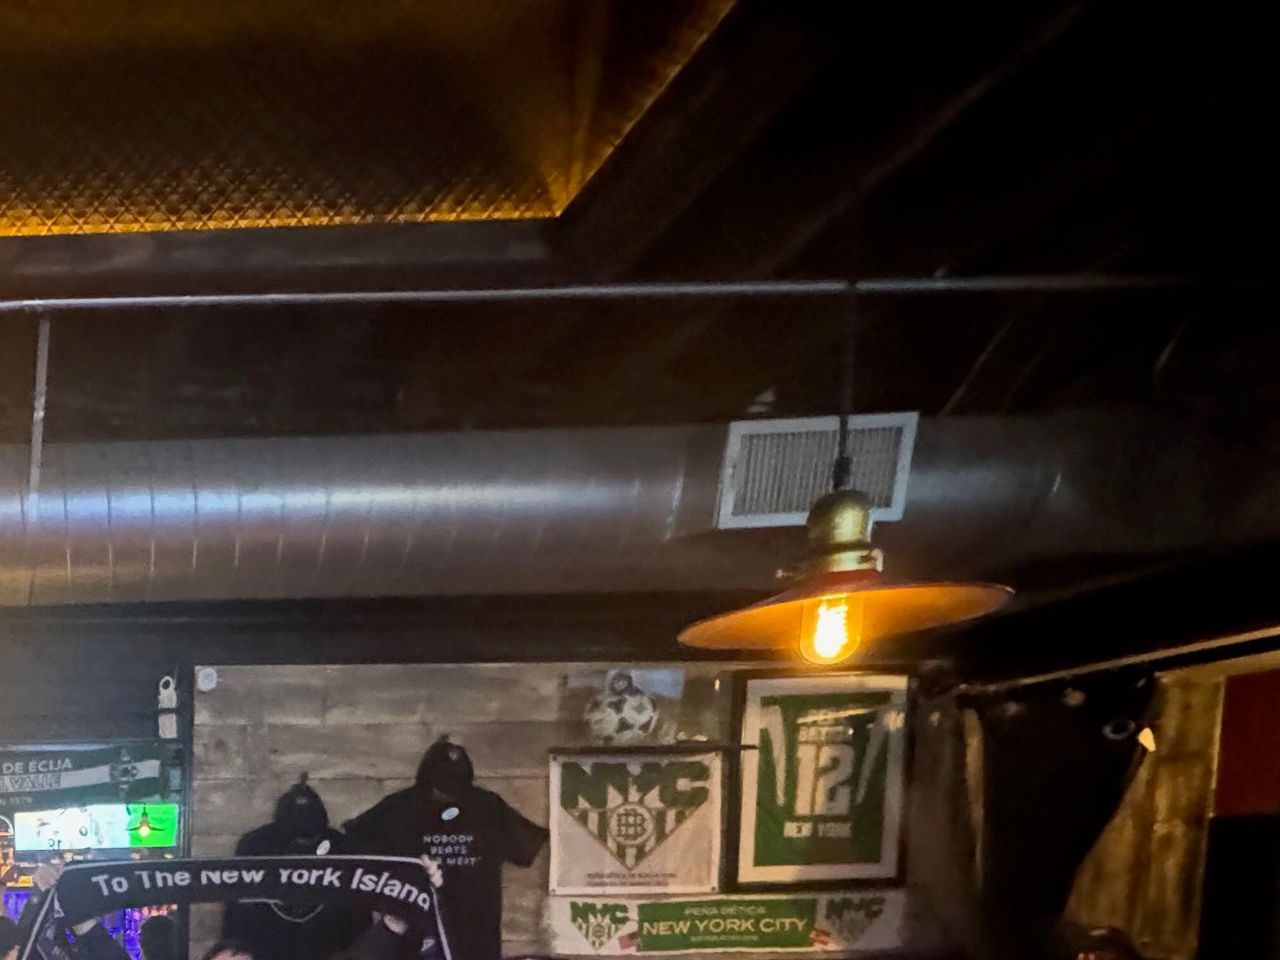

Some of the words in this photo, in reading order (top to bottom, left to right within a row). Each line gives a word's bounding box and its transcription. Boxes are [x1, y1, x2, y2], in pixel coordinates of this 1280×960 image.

[3, 762, 24, 774] DE
[10, 774, 62, 790] VALLE
[794, 743, 854, 816] 12
[423, 834, 474, 844] NOBODY
[91, 874, 128, 897] To
[134, 870, 191, 890] The
[201, 869, 264, 884] New
[280, 868, 341, 887] York
[642, 920, 690, 936] NEW
[695, 918, 755, 933] YORK
[759, 917, 808, 933] CITY
